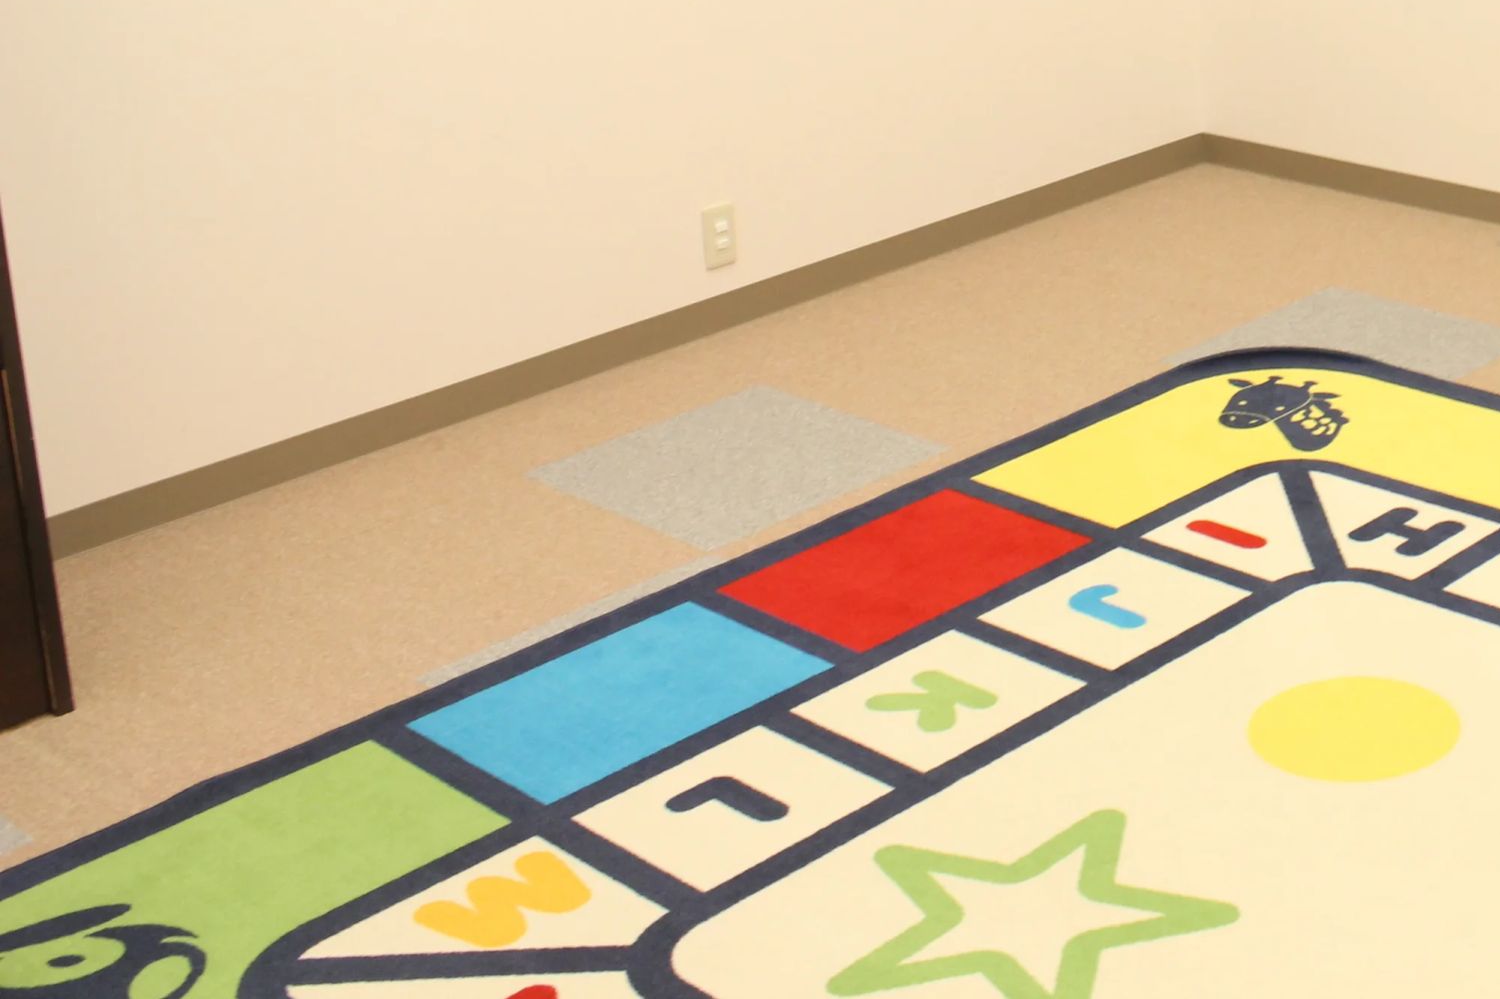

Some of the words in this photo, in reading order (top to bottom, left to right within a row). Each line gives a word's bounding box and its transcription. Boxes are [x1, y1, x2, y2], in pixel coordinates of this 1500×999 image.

[1186, 520, 1267, 549] I
[1347, 507, 1466, 557] H
[1069, 585, 1146, 628] J
[866, 671, 997, 731] K
[664, 776, 790, 822] L
[413, 851, 591, 947] M
